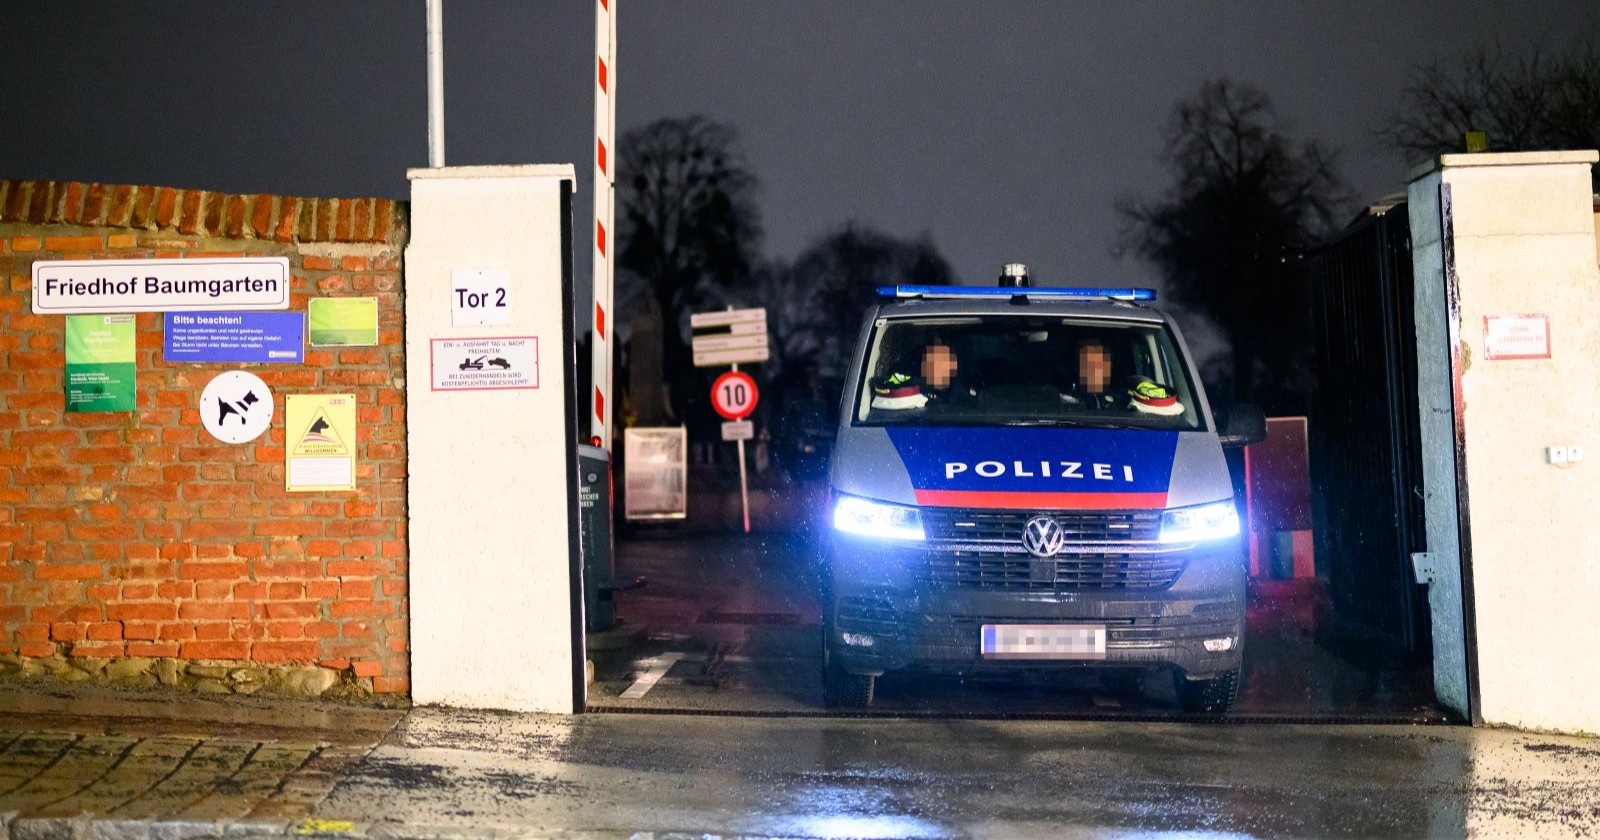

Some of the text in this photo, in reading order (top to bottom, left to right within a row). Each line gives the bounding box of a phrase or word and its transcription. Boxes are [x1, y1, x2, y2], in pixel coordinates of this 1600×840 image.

[46, 276, 277, 297] Friedhof Baumgarten
[455, 287, 506, 308] Tor 2
[173, 315, 242, 325] Bitte beachten!
[723, 384, 746, 407] 10
[945, 461, 1134, 483] POLIZEI
[1021, 515, 1065, 557] VW
